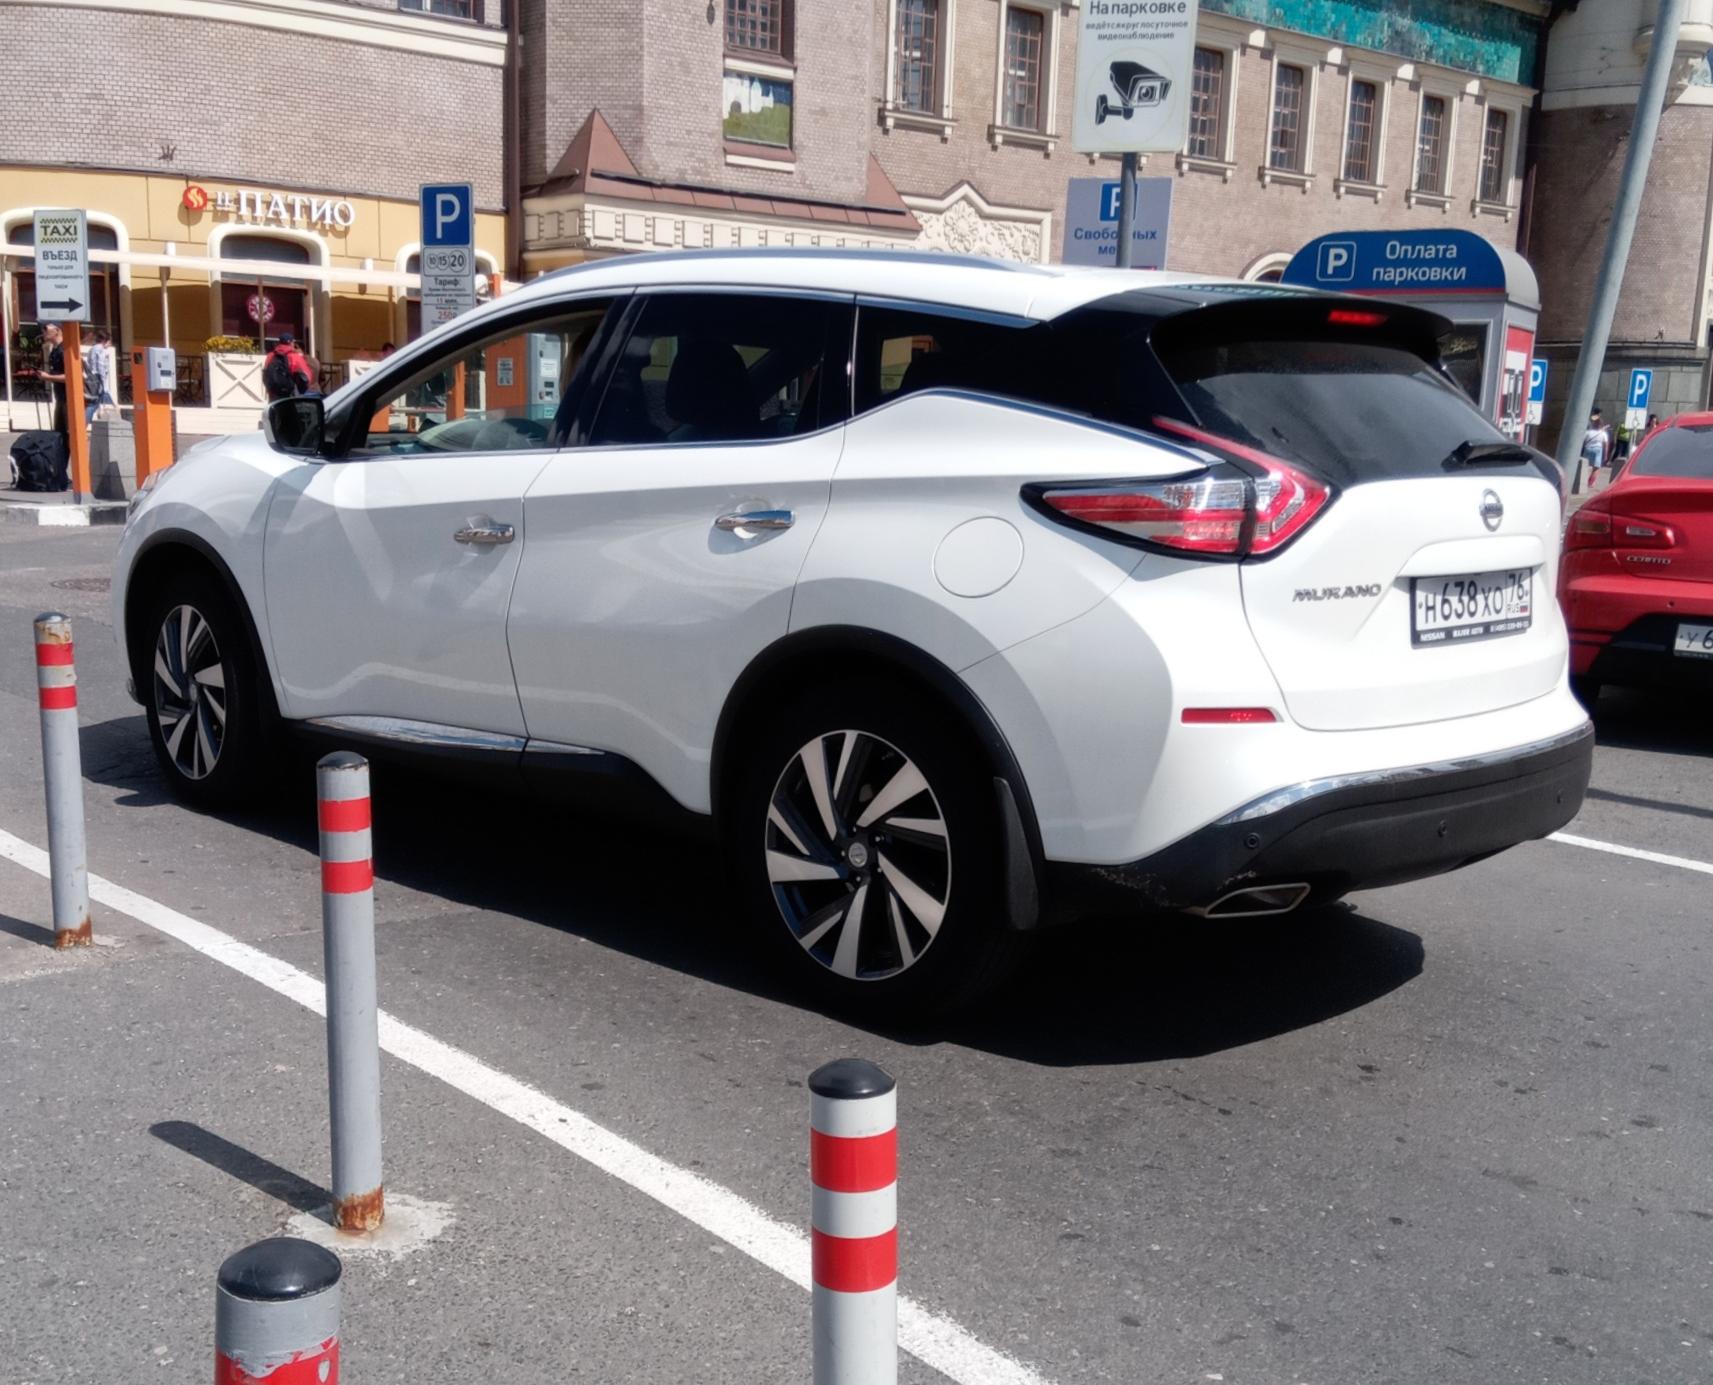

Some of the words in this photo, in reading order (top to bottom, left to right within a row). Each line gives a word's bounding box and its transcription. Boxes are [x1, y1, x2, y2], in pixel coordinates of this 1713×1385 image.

[1111, 2, 1186, 17] парковке
[238, 190, 355, 226] ПАТИО
[436, 193, 460, 239] P
[41, 225, 77, 236] TAXI
[42, 250, 78, 261] ВЪЕЗД
[1385, 241, 1458, 259] Оплата
[438, 255, 447, 266] 15
[450, 254, 465, 268] 20
[1327, 248, 1348, 275] P
[1372, 266, 1467, 285] парковки
[1528, 364, 1543, 399] P
[1633, 373, 1648, 406] P
[1291, 584, 1382, 602] MURANO
[1508, 573, 1525, 602] 76
[1420, 630, 1446, 642] NISSAN
